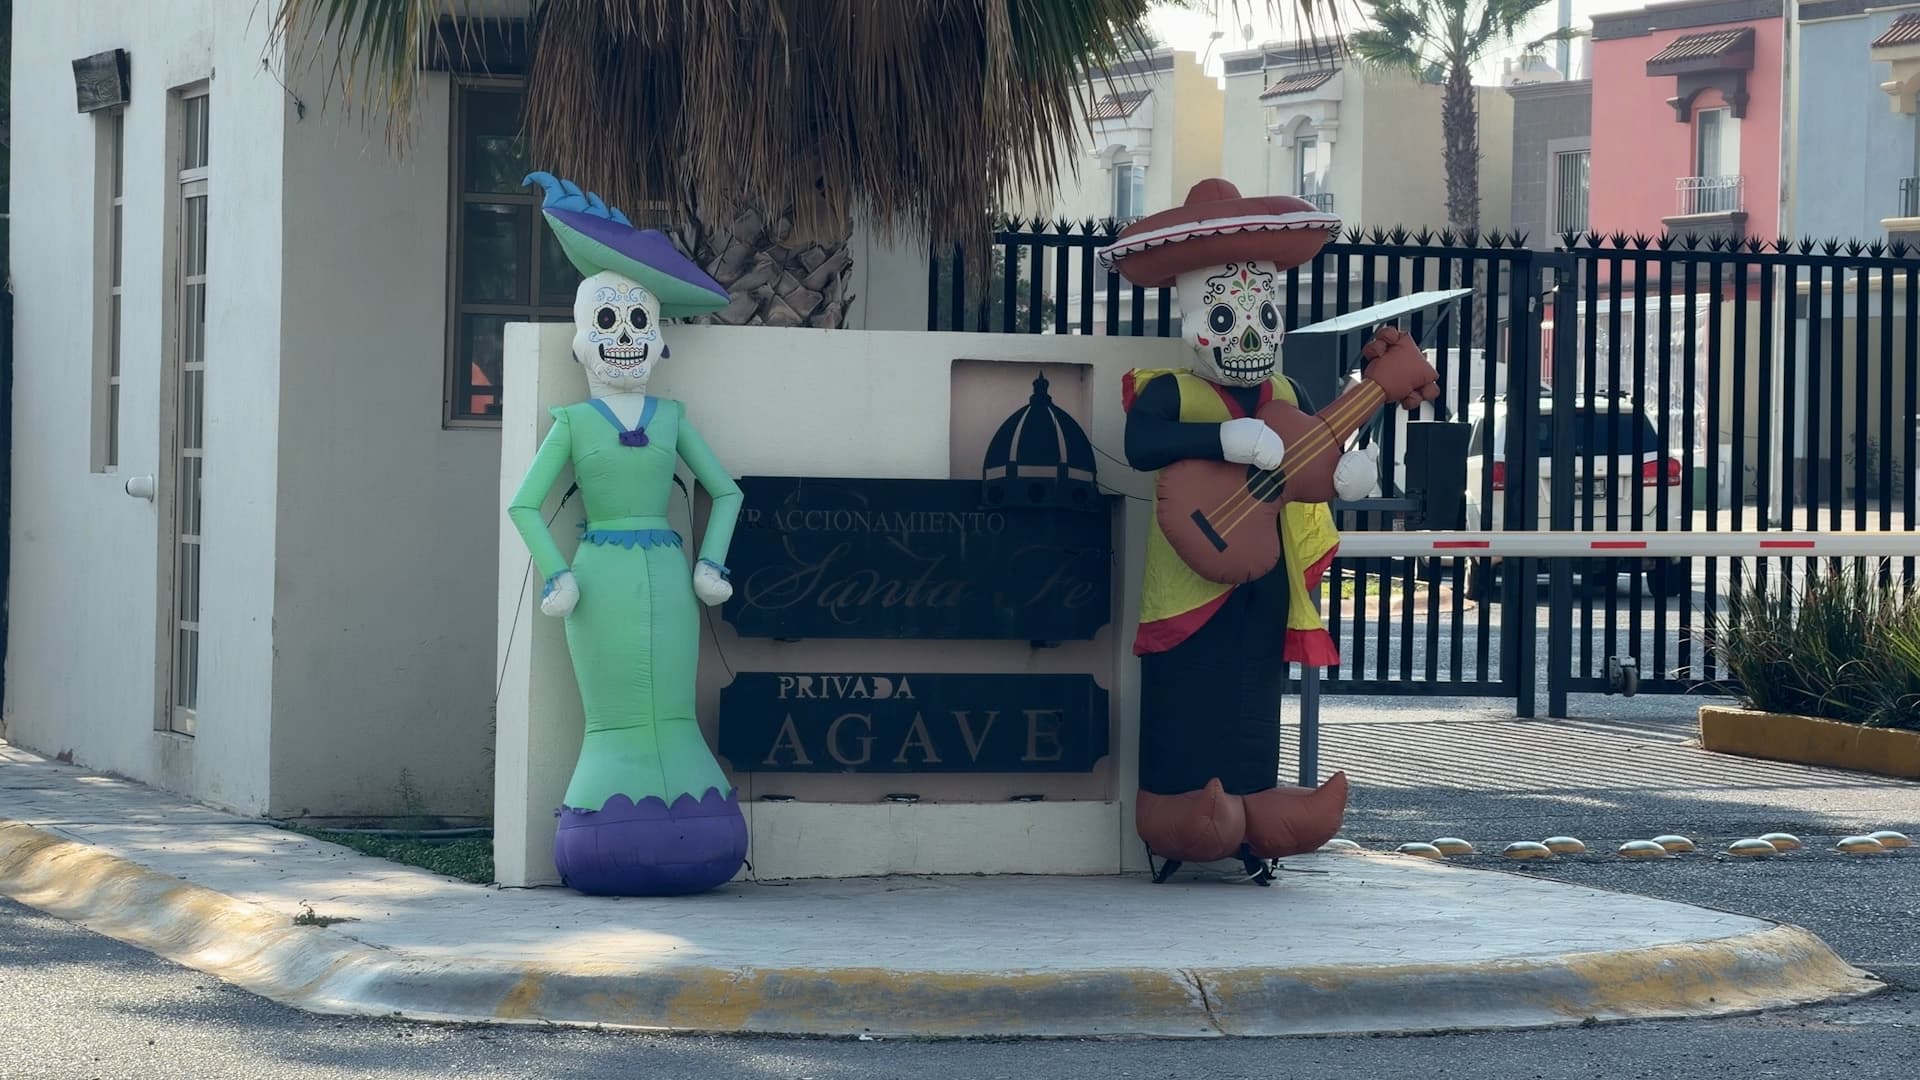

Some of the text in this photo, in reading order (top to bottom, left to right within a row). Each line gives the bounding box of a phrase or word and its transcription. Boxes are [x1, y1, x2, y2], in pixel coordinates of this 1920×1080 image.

[738, 540, 1096, 624] Santa Fe
[778, 675, 915, 699] PRIVADA
[763, 709, 1064, 766] AGAVE
